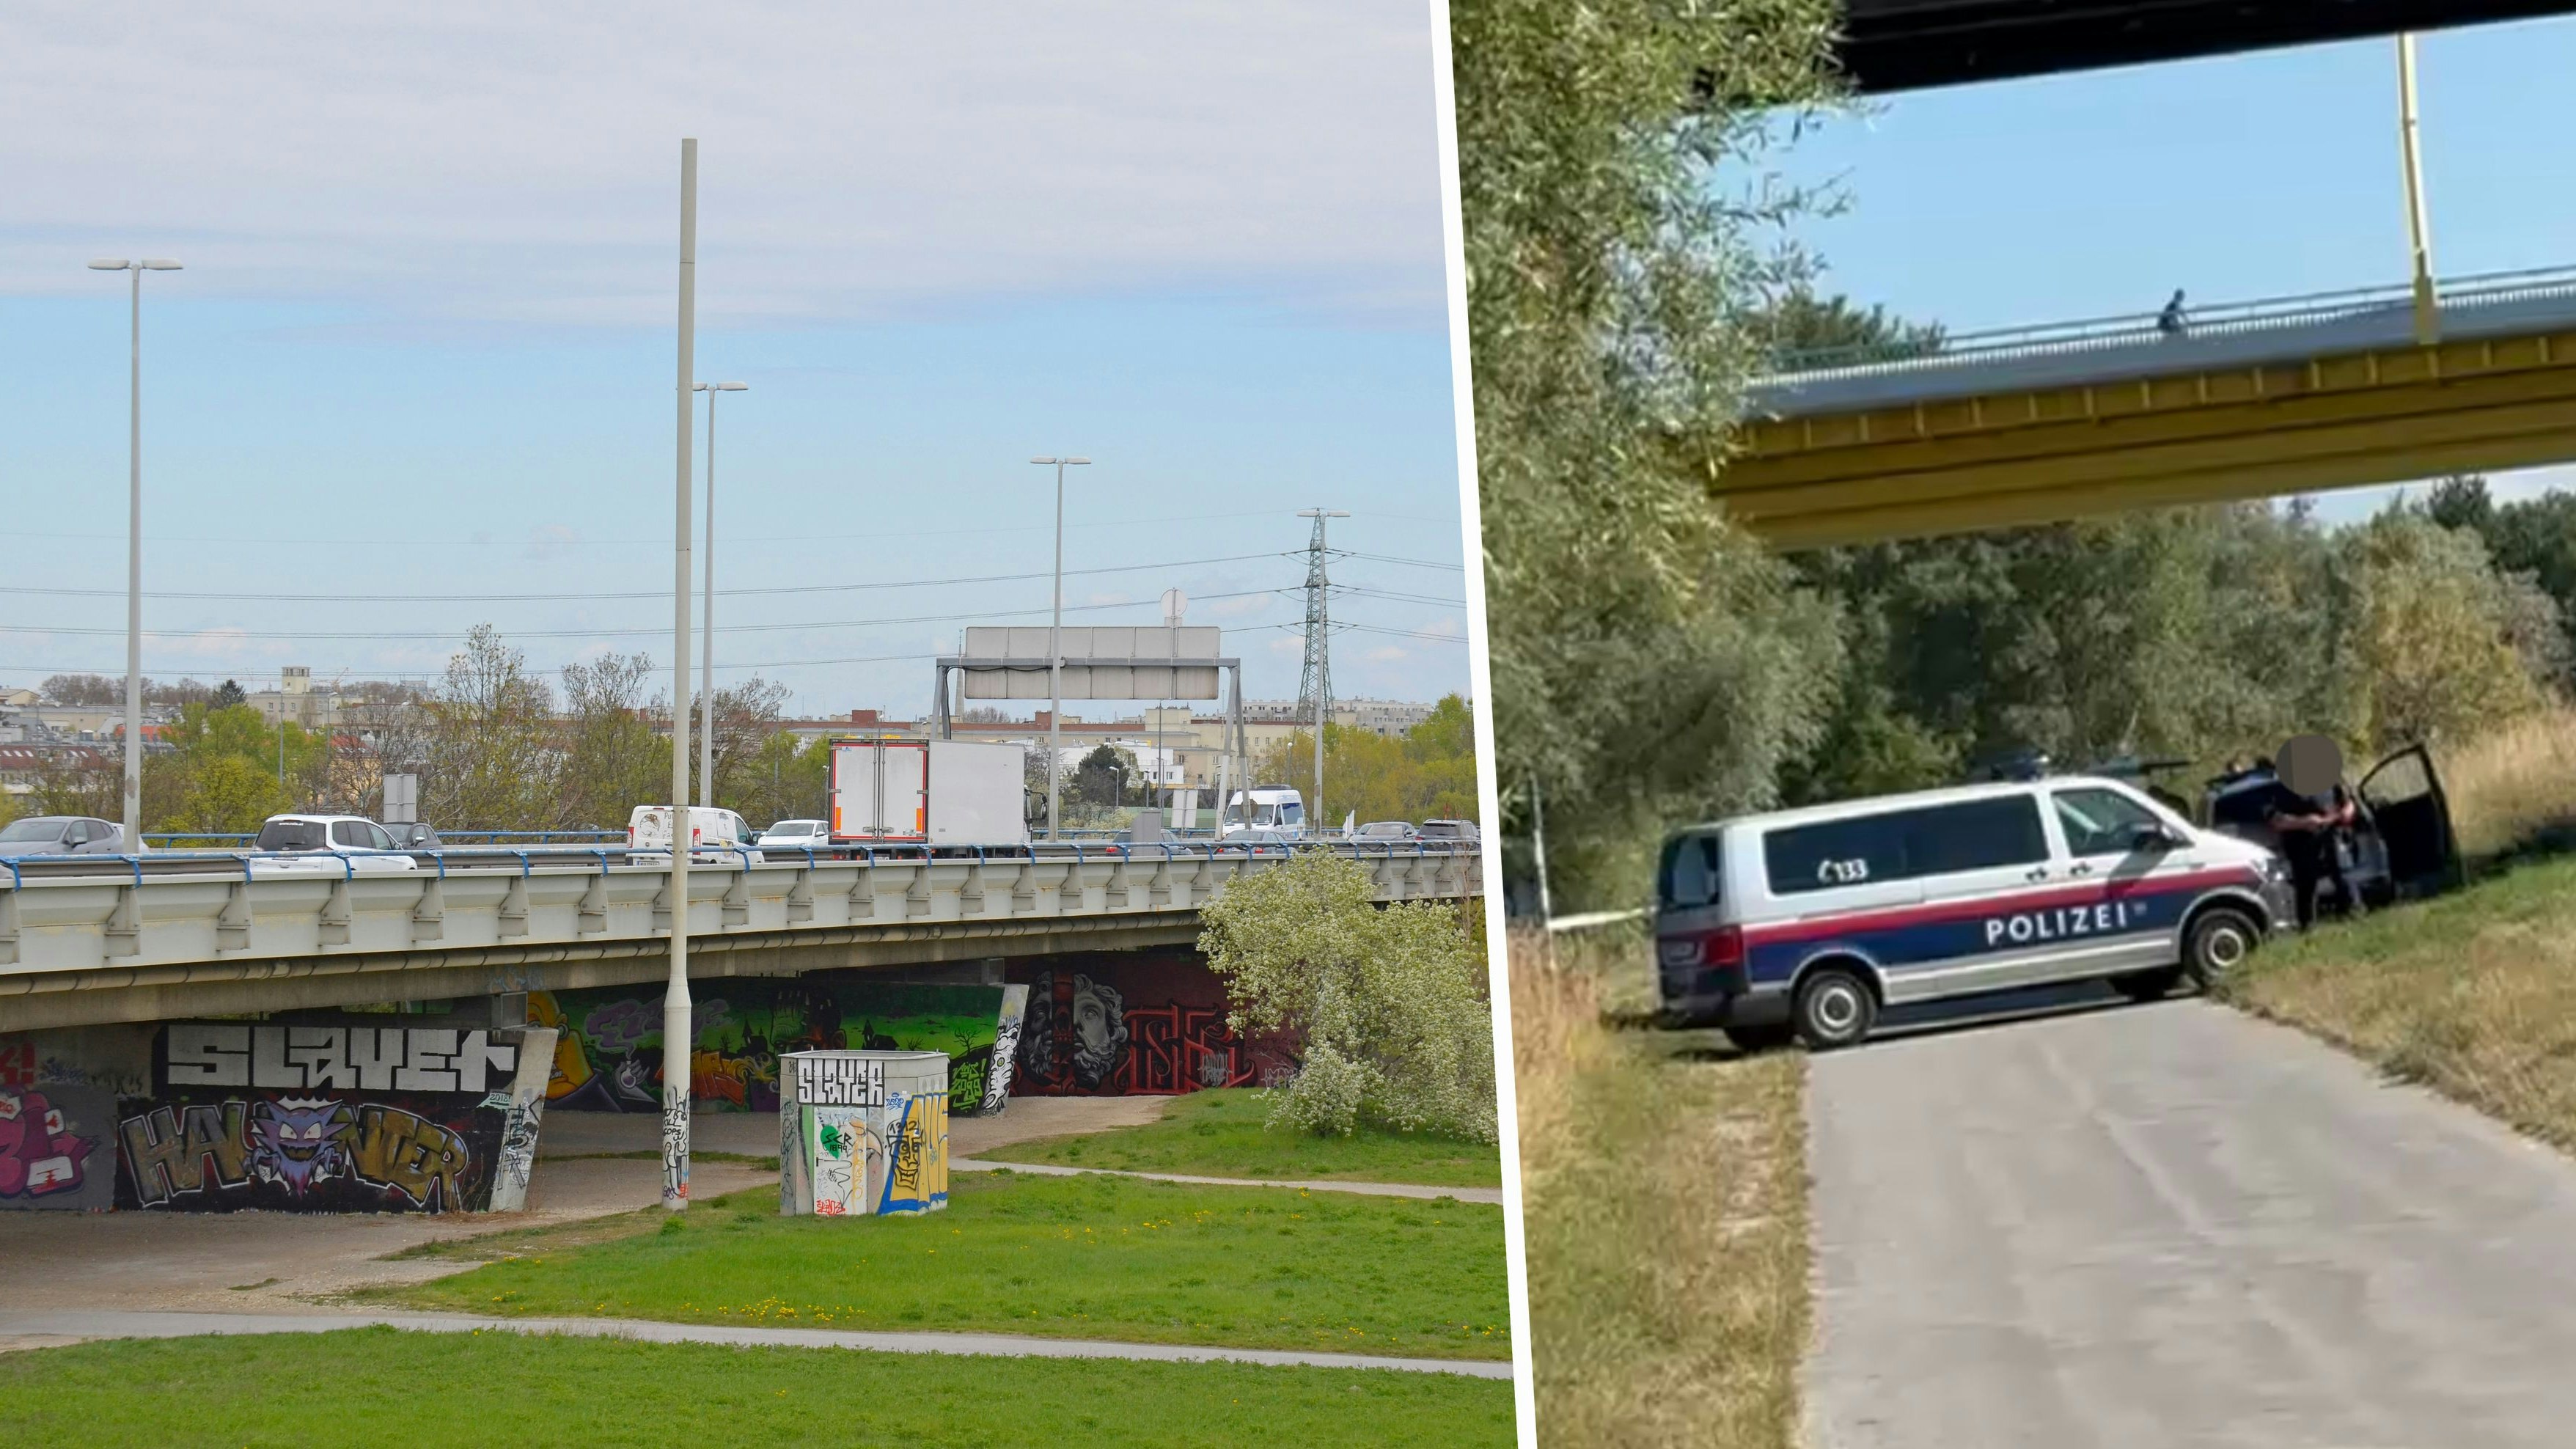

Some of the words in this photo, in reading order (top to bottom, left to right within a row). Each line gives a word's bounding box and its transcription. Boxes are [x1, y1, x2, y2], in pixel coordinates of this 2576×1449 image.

[1833, 858, 1868, 881] 133
[1986, 902, 2126, 946] POLIZEI
[889, 1120, 919, 1134] 1312
[823, 1132, 854, 1147] SCR
[829, 1144, 848, 1153] 1899
